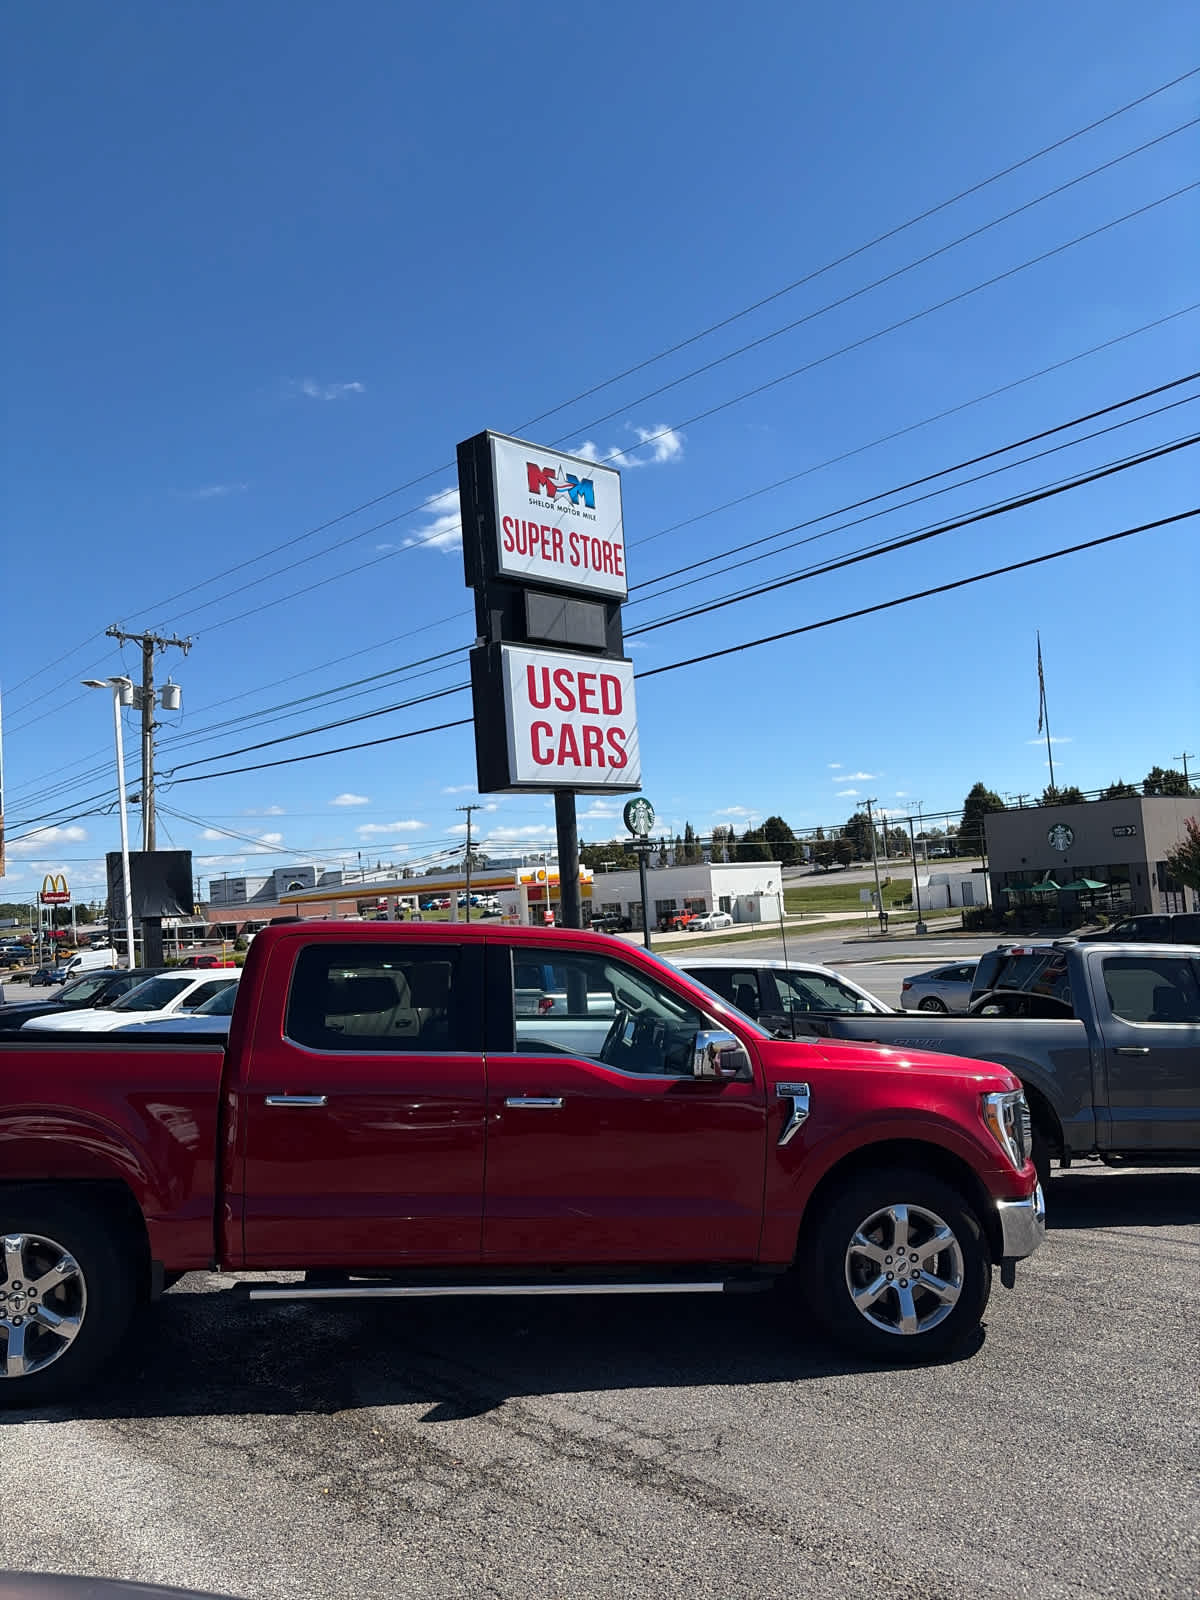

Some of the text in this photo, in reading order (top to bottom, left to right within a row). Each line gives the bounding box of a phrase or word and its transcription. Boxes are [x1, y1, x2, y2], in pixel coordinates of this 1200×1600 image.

[528, 498, 597, 521] SHELOR MOTOR MILE
[502, 515, 624, 577] SUPER STORE
[527, 665, 623, 716] USED
[530, 720, 628, 769] CARS
